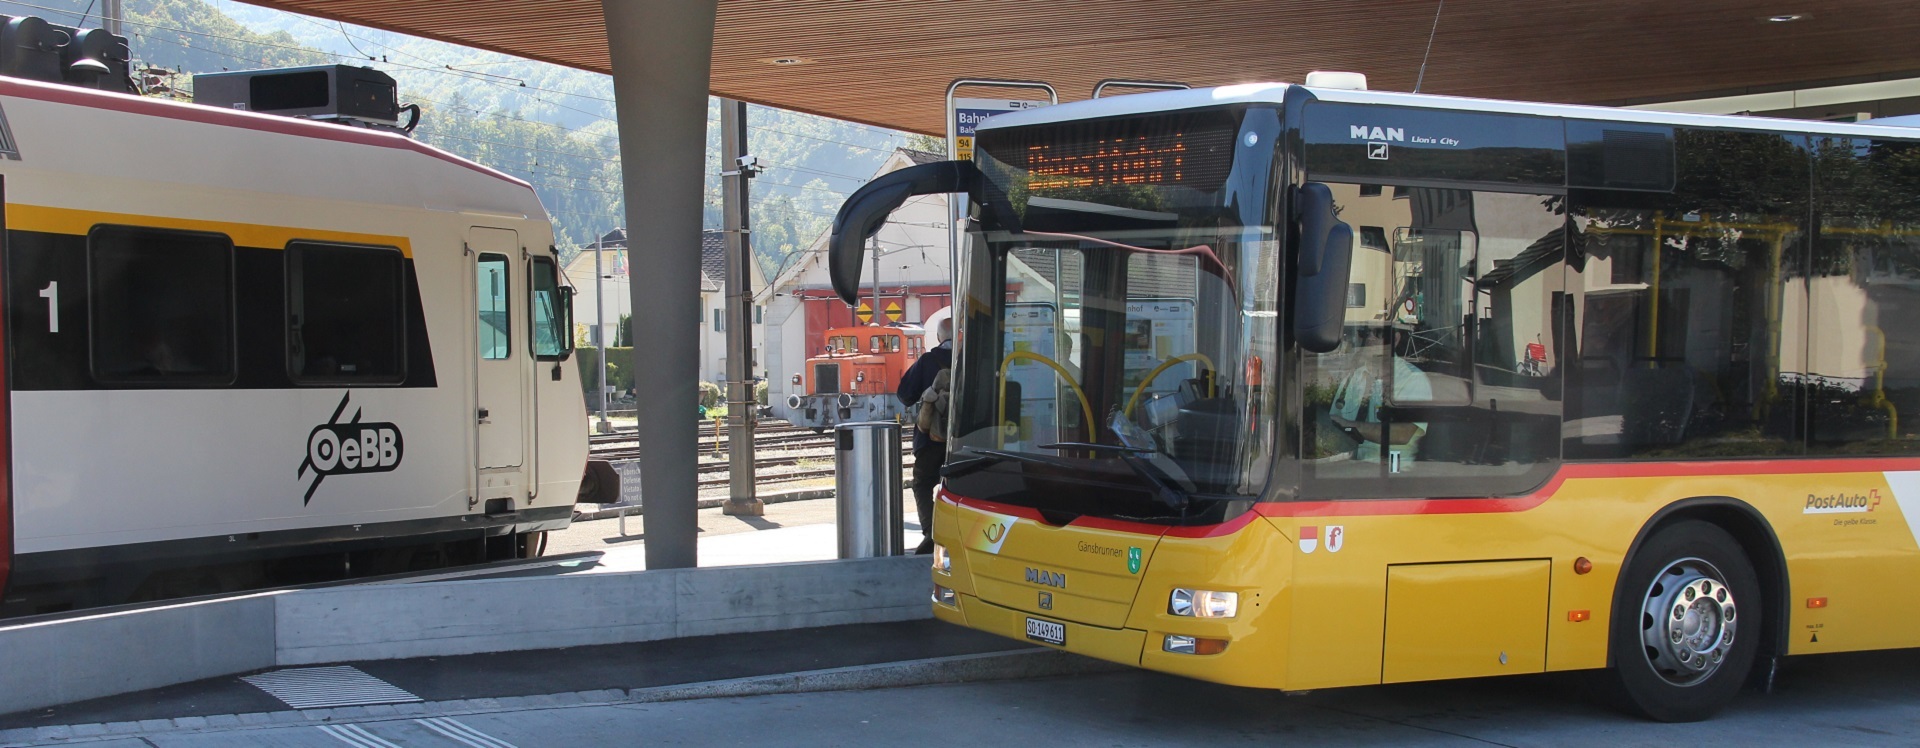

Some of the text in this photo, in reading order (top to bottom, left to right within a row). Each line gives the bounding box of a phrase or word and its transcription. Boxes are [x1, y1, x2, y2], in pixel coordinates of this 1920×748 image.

[960, 126, 975, 134] Bals
[1350, 125, 1460, 146] MAN Lion's City
[958, 139, 970, 148] 94
[1028, 133, 1186, 191] Dienstfahrt
[39, 281, 59, 333] 1
[1127, 304, 1144, 313] nhof
[310, 428, 398, 472] OeBB
[1806, 493, 1868, 510] PostAuto
[1077, 540, 1123, 558] Gänsbrunnen
[1025, 567, 1066, 589] MAN
